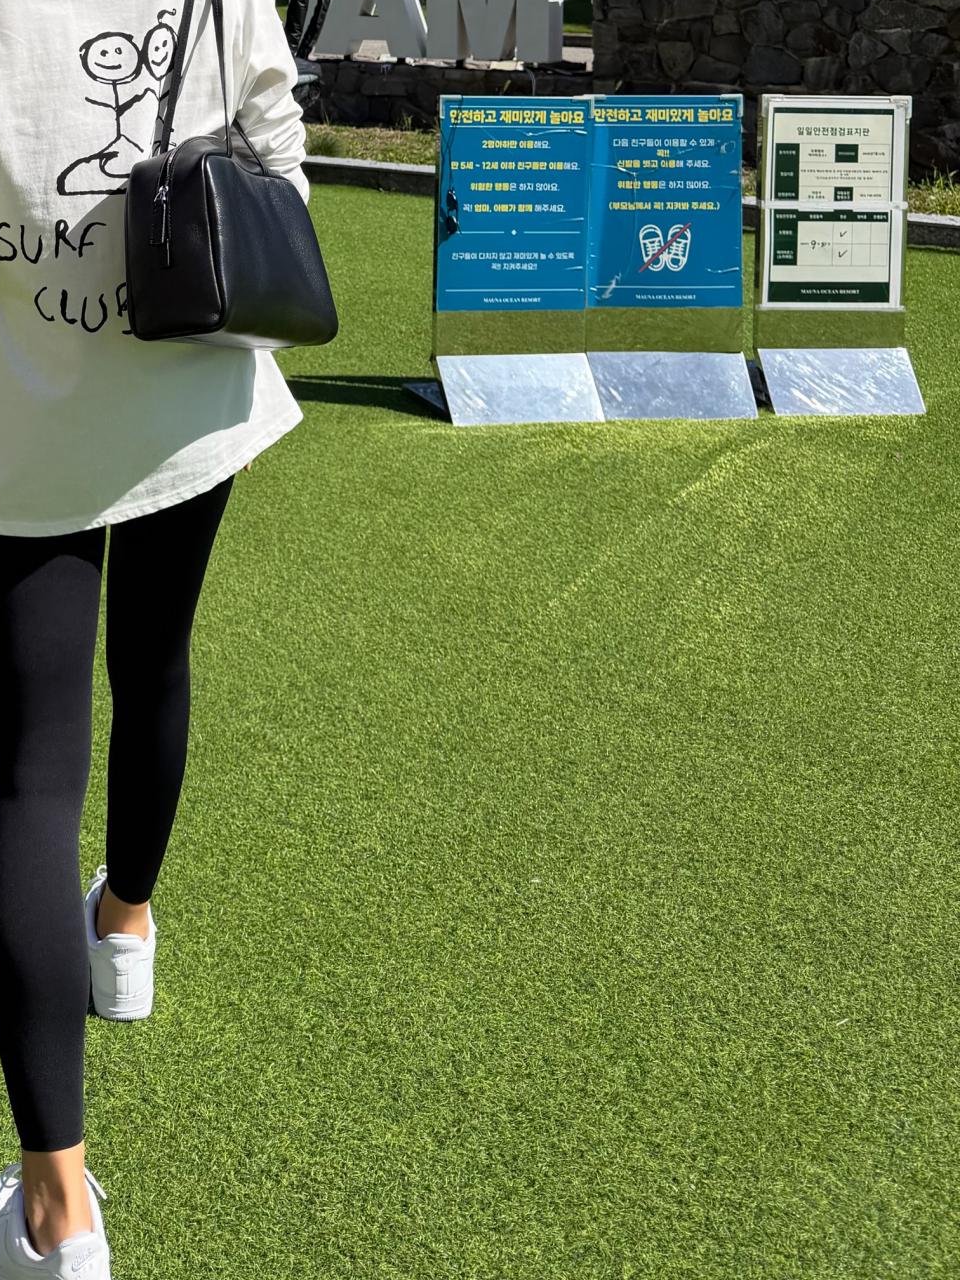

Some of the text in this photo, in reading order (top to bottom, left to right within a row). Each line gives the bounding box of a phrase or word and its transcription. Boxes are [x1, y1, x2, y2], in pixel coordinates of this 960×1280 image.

[450, 109, 584, 124] 안전하고 재미있게 놀아요
[594, 108, 733, 123] 안전하고 재미있게 놀아요
[613, 138, 715, 148] 다음 친구들이 이용할 수 있게
[518, 182, 533, 191] 하지
[668, 180, 684, 189] 하지
